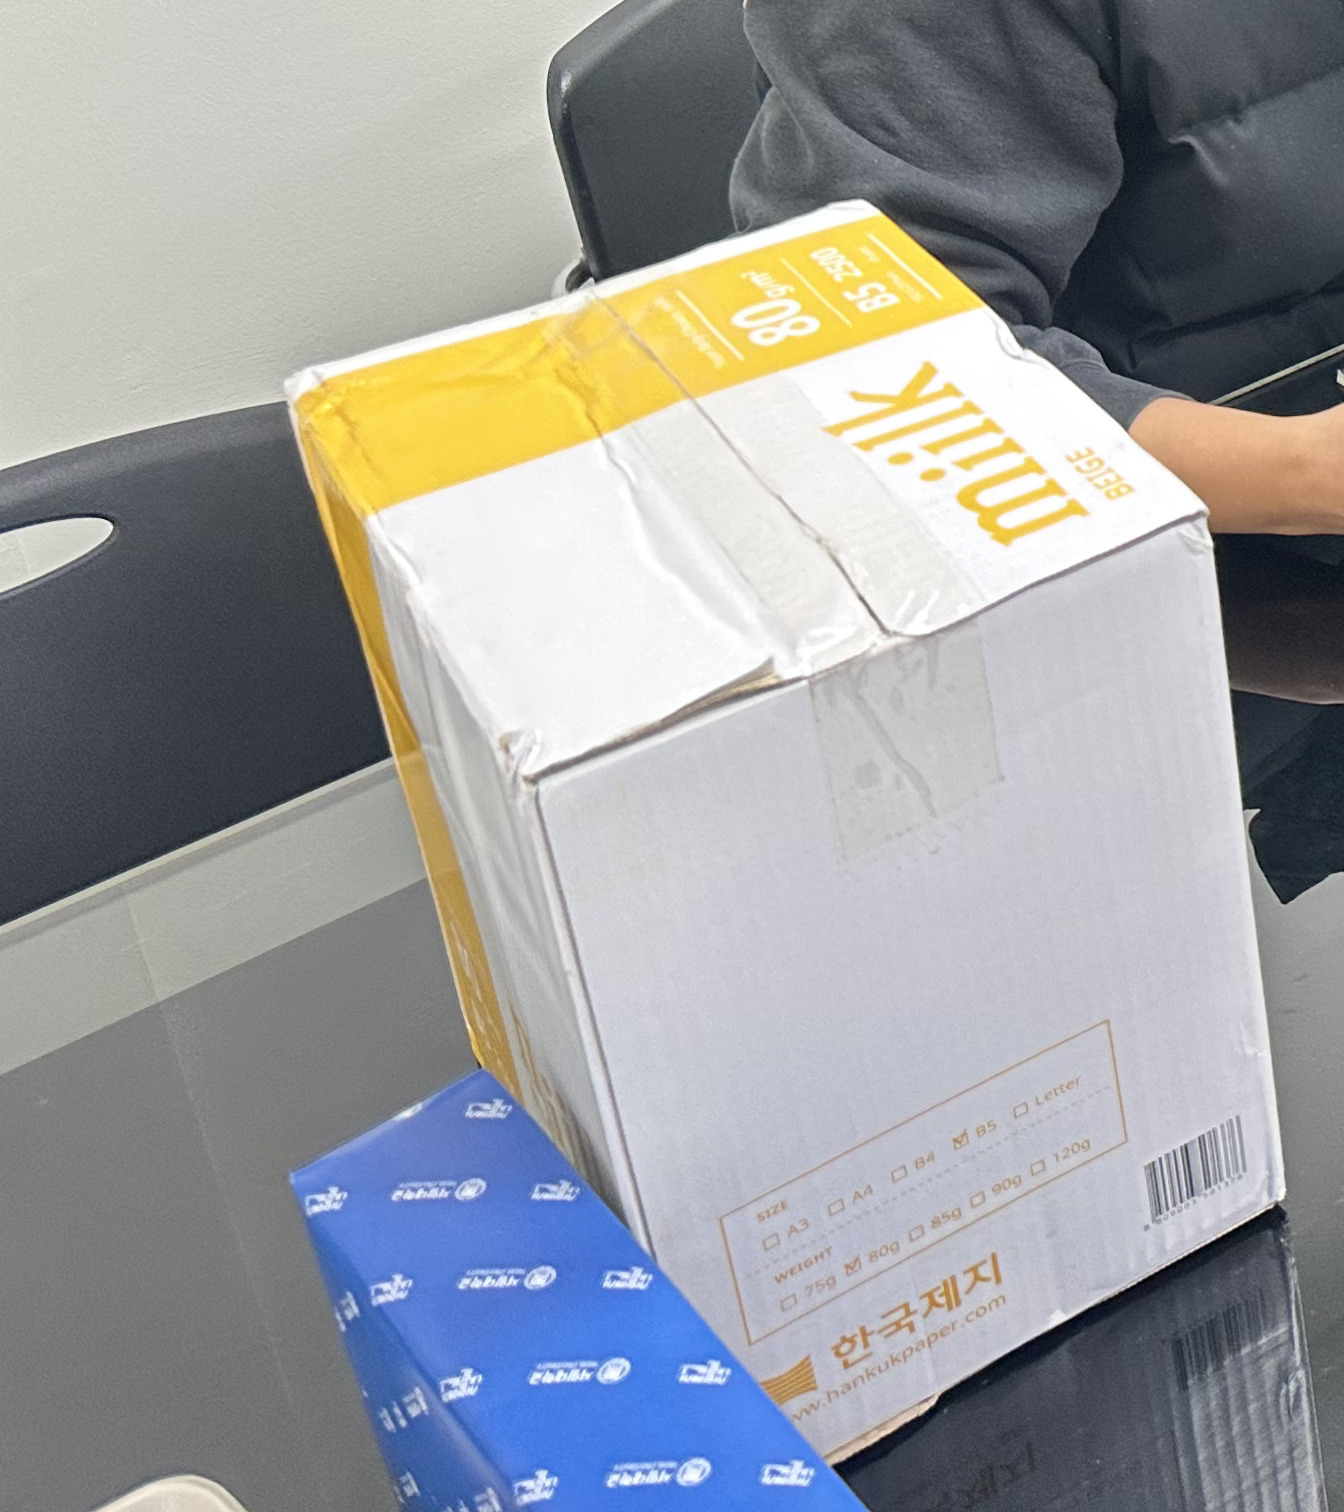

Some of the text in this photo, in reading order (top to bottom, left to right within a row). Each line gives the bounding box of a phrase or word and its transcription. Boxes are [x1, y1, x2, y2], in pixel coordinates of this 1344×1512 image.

[810, 246, 863, 283] 2500
[843, 281, 901, 313] B5
[820, 360, 1091, 547] miilk
[1064, 446, 1135, 501] BEIGE
[787, 1076, 1081, 1238] A3 A4 B4 B5 Letter
[756, 1199, 789, 1223] SIZE
[804, 1139, 1091, 1297] 75g 80g 85g 90g 120g
[773, 1246, 833, 1284] WEIGHT
[831, 1251, 1003, 1369] 한국제지
